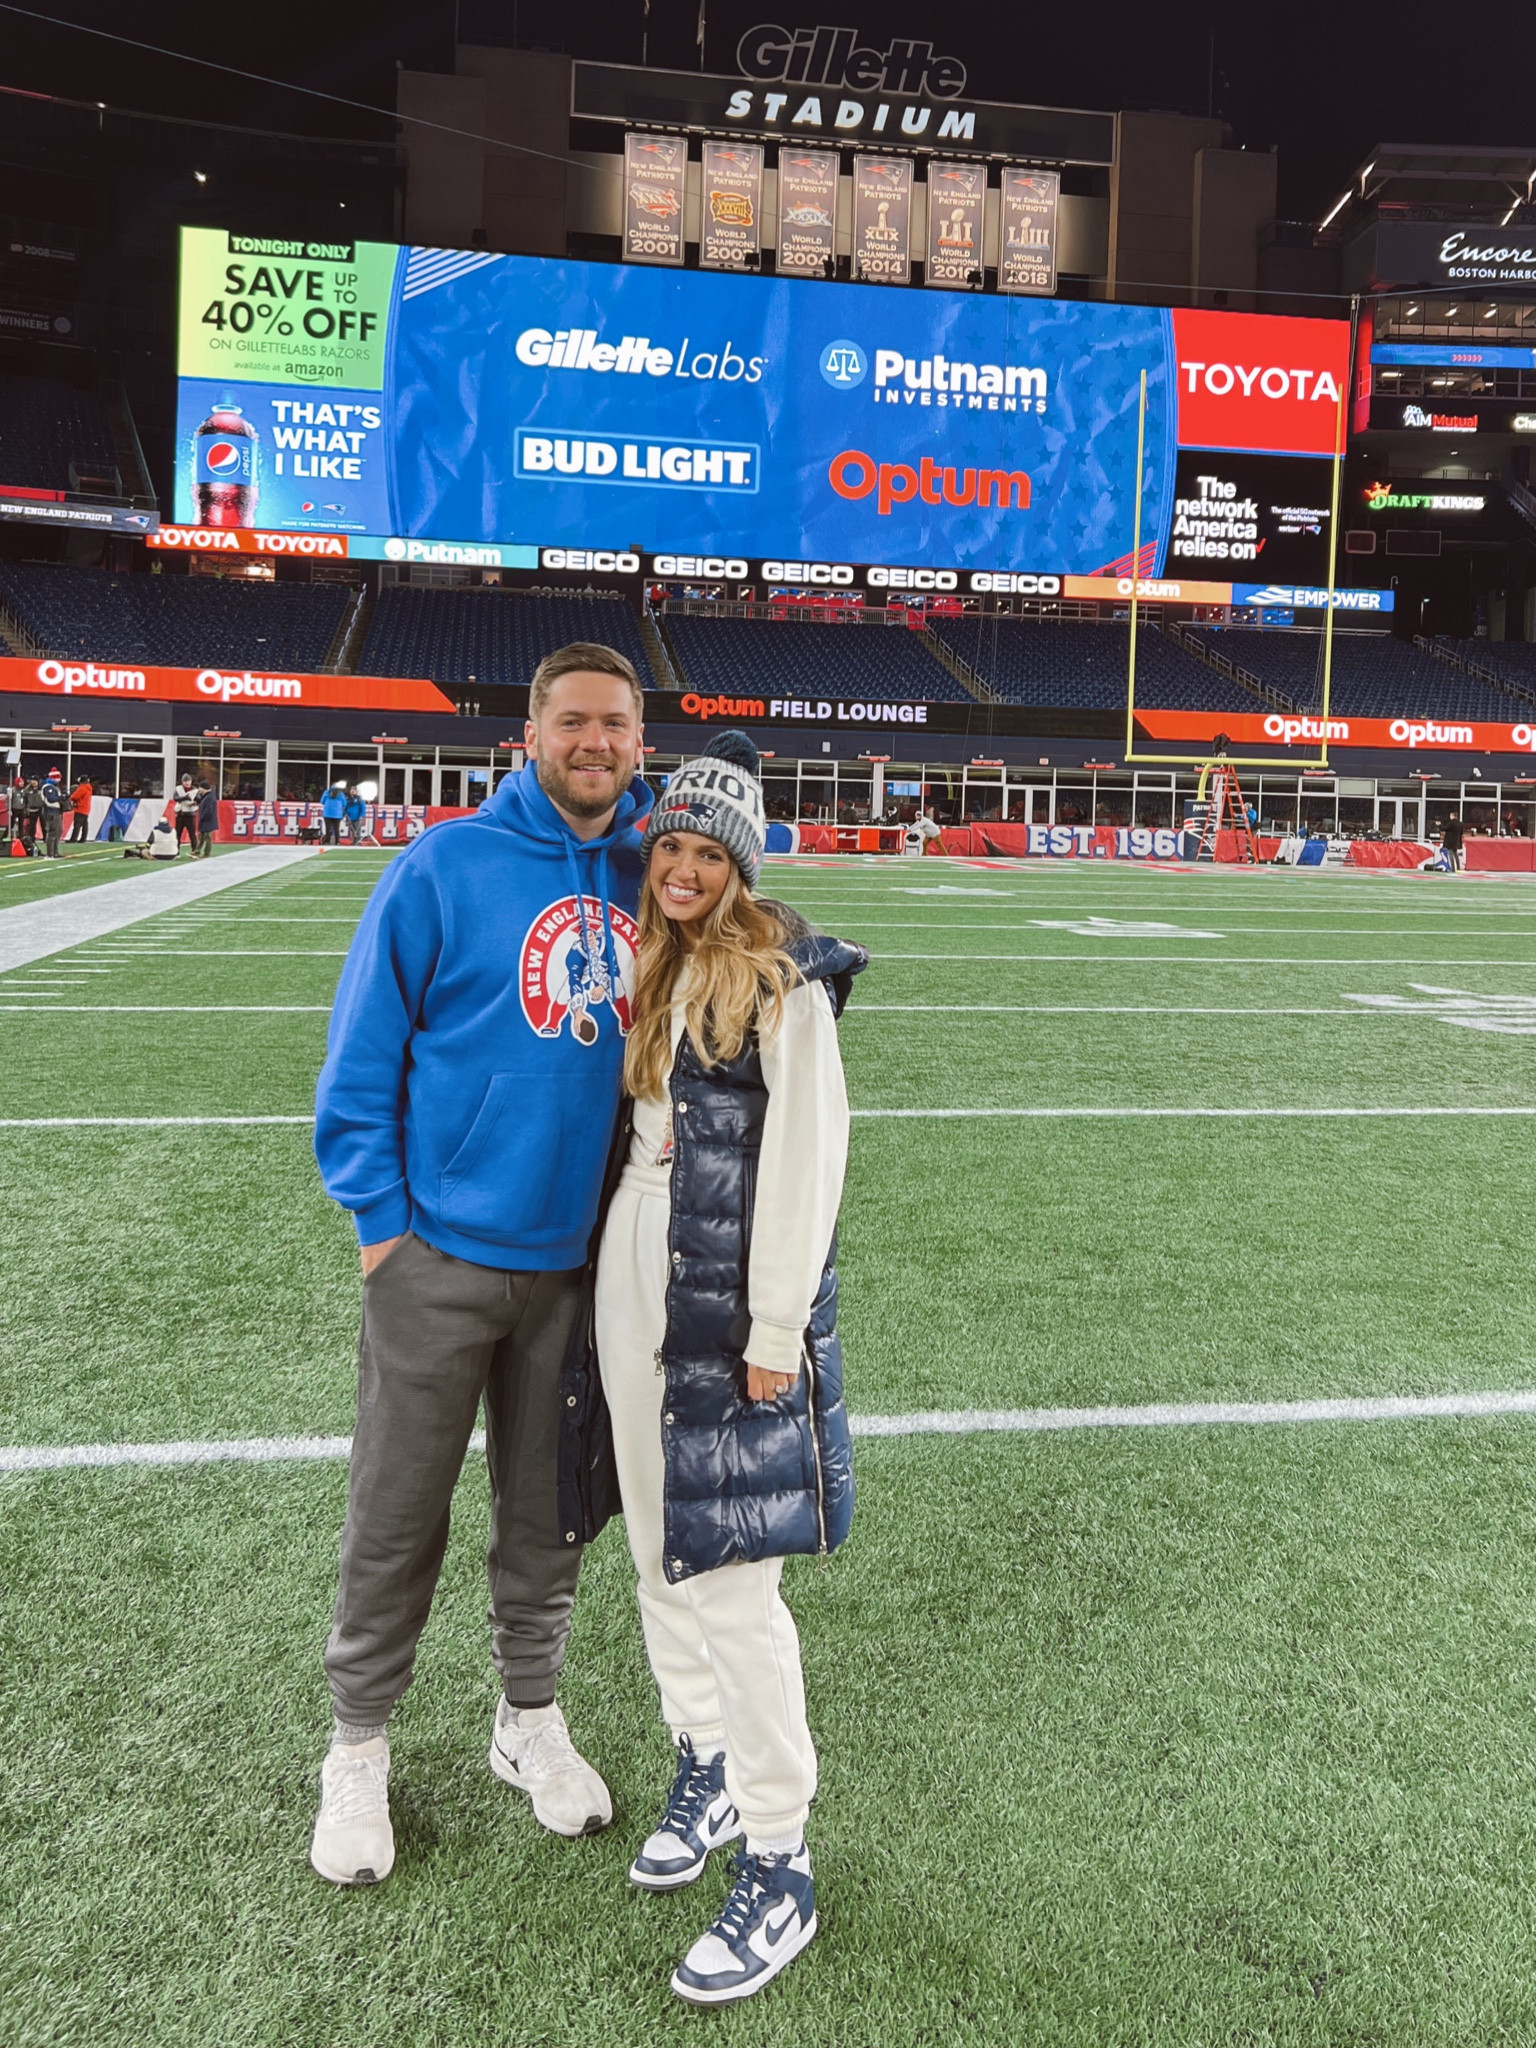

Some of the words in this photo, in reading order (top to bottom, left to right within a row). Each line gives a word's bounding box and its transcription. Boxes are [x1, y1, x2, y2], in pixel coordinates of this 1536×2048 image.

[736, 24, 968, 99] Gillette
[725, 89, 976, 140] STADIUM
[630, 162, 646, 171] NEW
[649, 164, 682, 173] ENGLAND
[636, 170, 676, 181] PATRIOTS
[708, 169, 724, 177] NEW
[726, 171, 758, 180] ENGLAND
[713, 177, 752, 188] PATRIOTS
[784, 176, 800, 184] NEW
[801, 177, 834, 187] ENGLAND
[789, 184, 828, 194] PATRIOTS
[859, 182, 875, 190] NEW
[876, 184, 908, 193] ENGLAND
[864, 190, 902, 200] PATRIOTS
[933, 189, 949, 197] NEW
[950, 191, 981, 200] ENGLAND
[938, 197, 976, 207] PATRIOTS
[1007, 196, 1022, 204] NEW
[1023, 197, 1054, 206] ENGLAND
[1012, 203, 1048, 213] PATRIOTS
[638, 221, 671, 232] WORLD
[715, 229, 747, 240] WORLD
[629, 230, 680, 242] CHAMPIONS
[706, 237, 756, 249] CHAMPIONS
[791, 235, 823, 245] WORLD
[865, 229, 900, 242] XLIX
[231, 236, 305, 256] TONIGHT
[306, 242, 351, 259] ONLY
[631, 240, 677, 256] 2001
[782, 243, 831, 254] CHAMPIONS
[866, 241, 897, 251] WORLD
[940, 248, 970, 258] WORLD
[1439, 231, 1536, 263] Encore
[857, 249, 906, 261] CHAMPIONS
[931, 256, 979, 267] CHAMPIONS
[1013, 253, 1043, 263] WORLD
[860, 259, 903, 274] 2014
[1004, 261, 1051, 272] CHAMPIONS
[1449, 267, 1497, 278] BOSTON
[224, 264, 324, 301] SAVE
[334, 272, 358, 287] UP
[334, 289, 358, 304] TO
[0, 314, 50, 331] WINNERS
[202, 300, 294, 336] 40%
[303, 307, 378, 341] OFF
[209, 338, 232, 350] ON
[236, 340, 317, 357] GILLETTELABS
[320, 346, 371, 360] RAZORS
[234, 361, 270, 371] available
[272, 363, 281, 371] at
[285, 362, 344, 377] amazon
[874, 349, 1048, 398] Putnam
[1181, 361, 1339, 402] TOYOTA
[874, 388, 1048, 414] INVESTMENTS
[271, 400, 381, 429] THAT'S
[1405, 413, 1432, 427] AIM
[1432, 414, 1479, 427] Mutual
[272, 427, 366, 454] WHAT
[242, 446, 250, 477] pepsi
[275, 453, 283, 475] I
[294, 455, 362, 480] LIKE
[523, 437, 618, 476] BUD
[623, 444, 751, 484] LIGHT
[829, 449, 1032, 515] Optum
[1197, 475, 1237, 499] The
[1175, 498, 1258, 519] network
[1368, 494, 1485, 511] DRAFTKINGS
[0, 503, 24, 514] NEW
[24, 506, 68, 518] ENGLAND
[68, 511, 113, 523] PATRIOTS
[1173, 516, 1257, 539] America
[153, 528, 240, 549] TOYOTA
[254, 534, 344, 555] TOYOTA
[1174, 536, 1229, 558] relies
[1230, 543, 1256, 560] on
[407, 541, 501, 566] Putnam
[542, 549, 640, 573] GEICO
[653, 556, 749, 579] GEICO
[761, 562, 854, 585] GEICO
[867, 567, 958, 590] GEICO
[971, 573, 1060, 595] GEICO
[1294, 590, 1381, 608] EMPOWER
[37, 660, 146, 693] Optum
[197, 670, 302, 702] Optum
[680, 693, 765, 720] Optum
[770, 700, 832, 719] FIELD
[837, 703, 928, 723] LOUNGE
[1264, 714, 1349, 743] Optum
[1389, 719, 1473, 748] Optum
[1027, 825, 1106, 856] EST.
[527, 948, 544, 999] NEW
